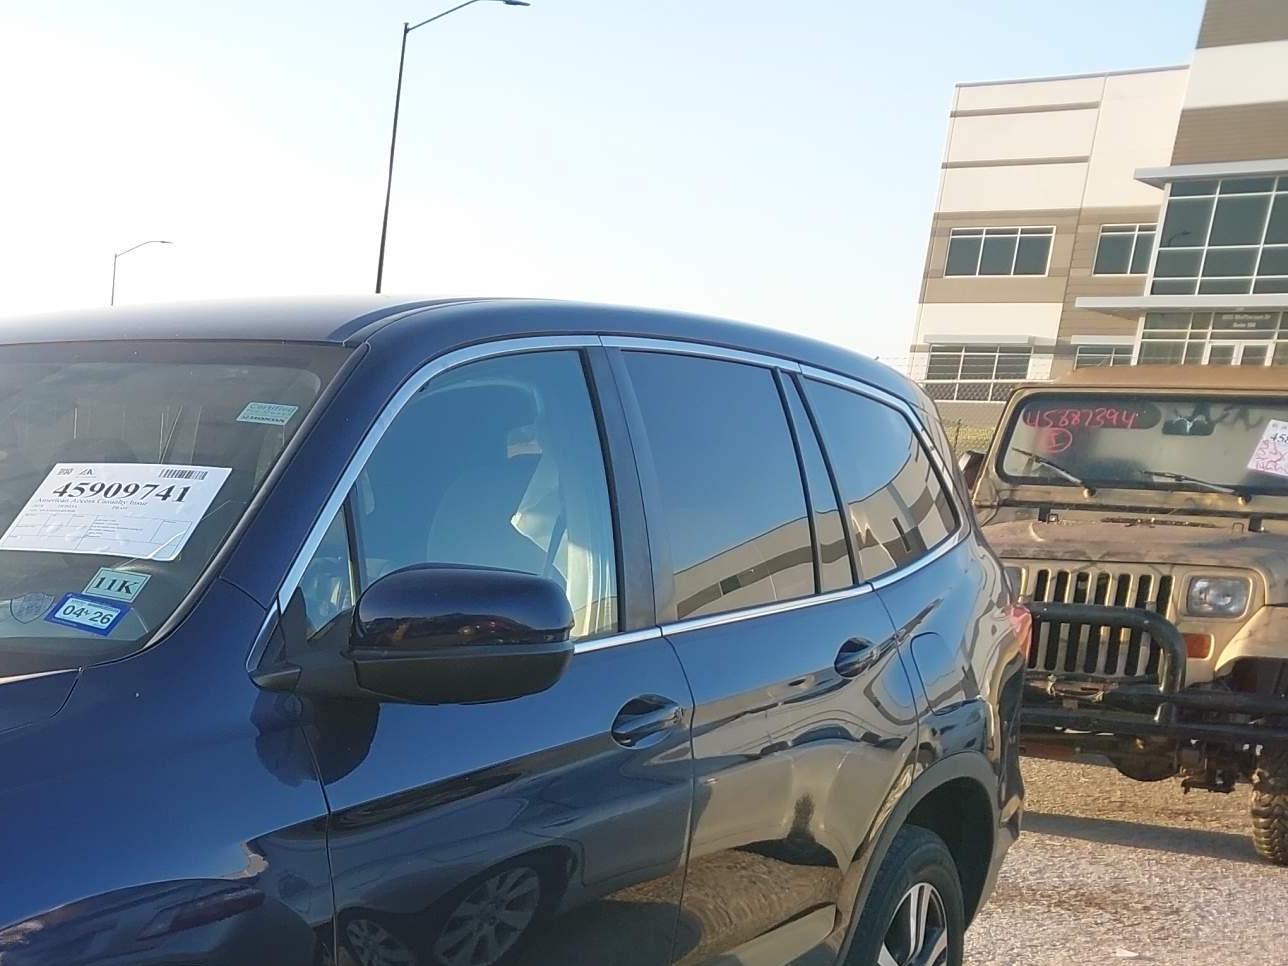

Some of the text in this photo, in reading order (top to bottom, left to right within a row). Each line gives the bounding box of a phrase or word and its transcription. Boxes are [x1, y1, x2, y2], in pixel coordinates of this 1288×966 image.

[53, 482, 191, 502] 45909741
[93, 577, 138, 594] 11K
[62, 605, 85, 618] 04
[88, 611, 113, 625] 26
